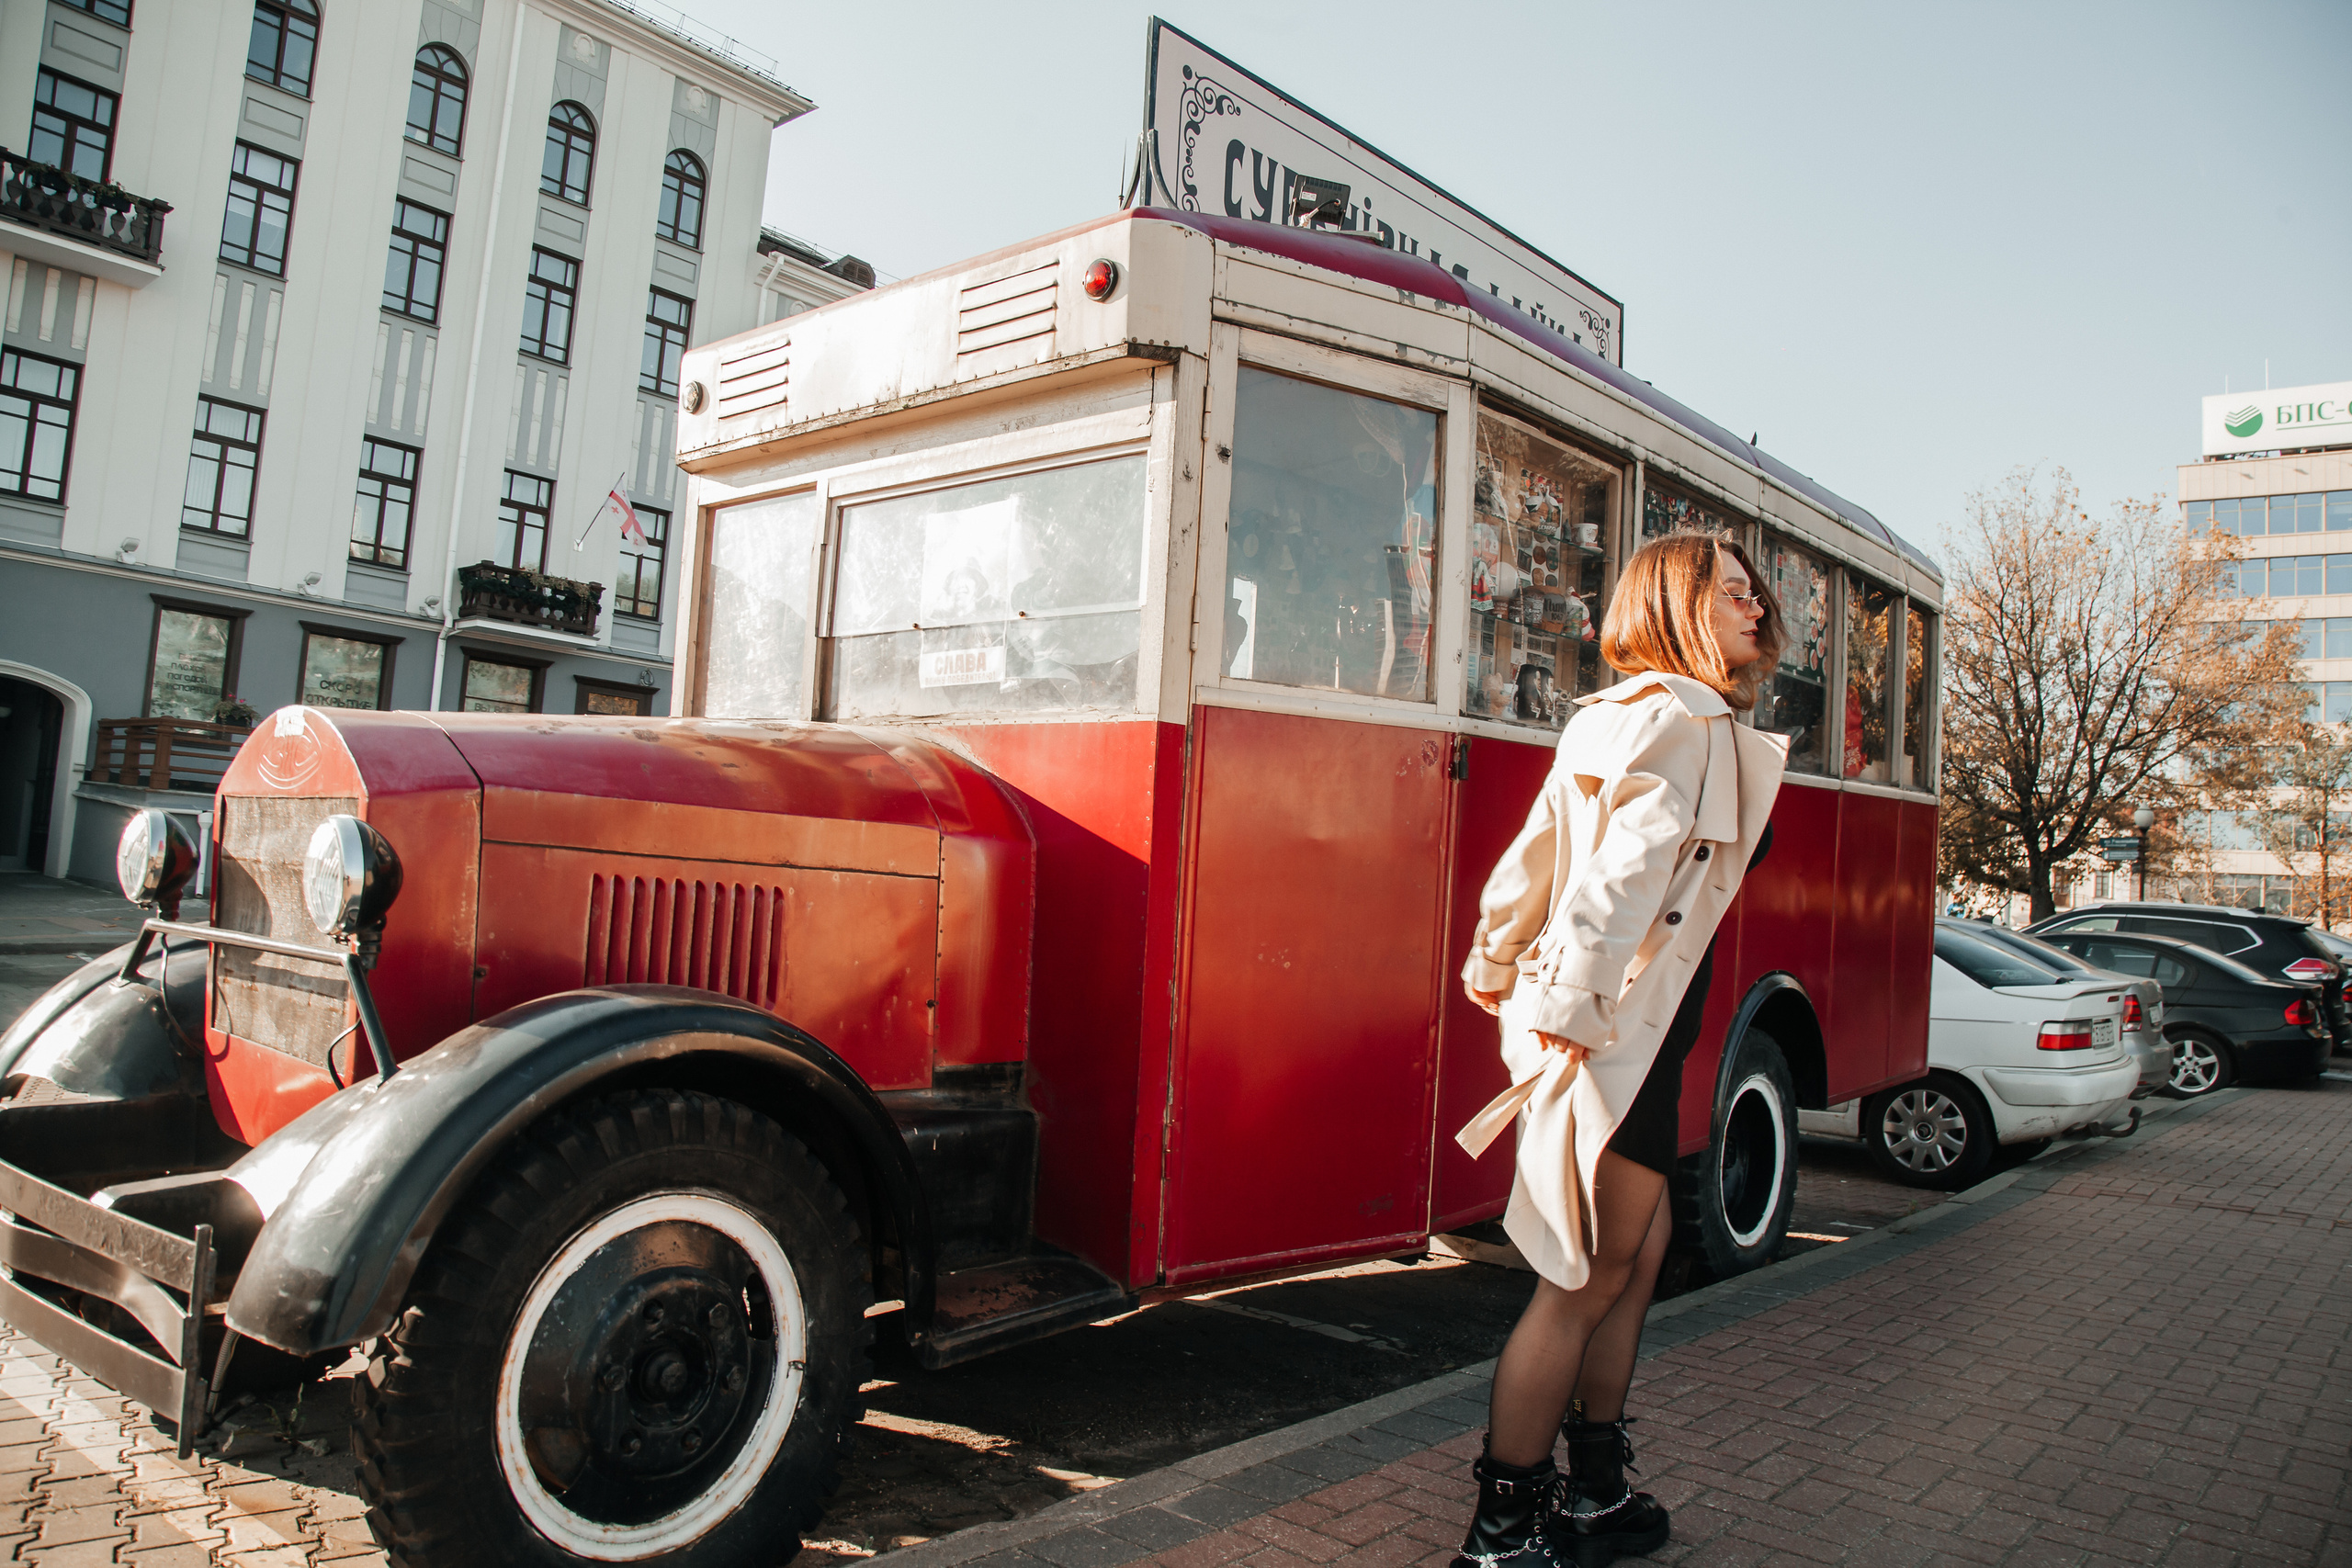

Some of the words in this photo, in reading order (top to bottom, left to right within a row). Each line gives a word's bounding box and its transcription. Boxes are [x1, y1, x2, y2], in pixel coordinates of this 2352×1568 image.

[2276, 400, 2352, 424] БПС-
[934, 652, 987, 675] СЛАВА
[167, 672, 208, 684] ПОГОДОЙ
[320, 680, 362, 694] СКОРО
[306, 694, 373, 709] ОТКРЫТИЕ
